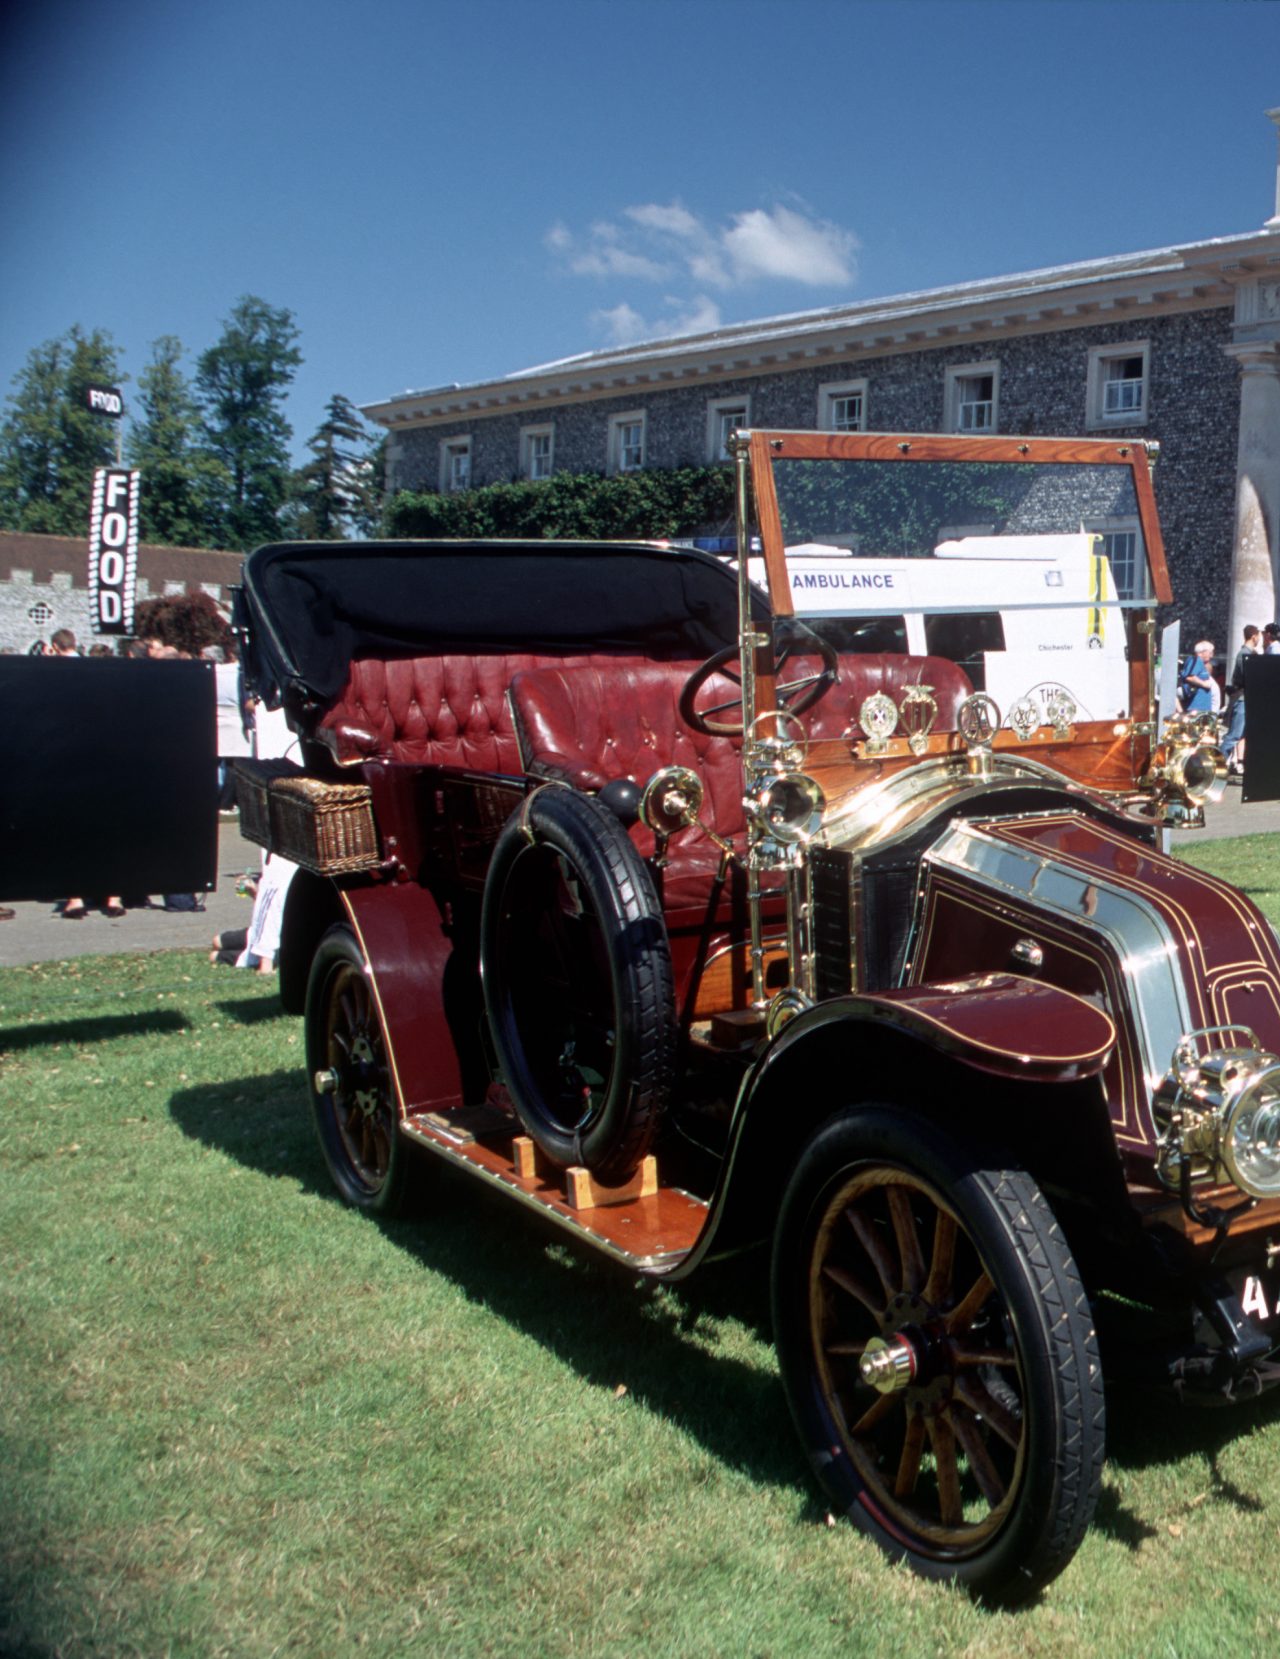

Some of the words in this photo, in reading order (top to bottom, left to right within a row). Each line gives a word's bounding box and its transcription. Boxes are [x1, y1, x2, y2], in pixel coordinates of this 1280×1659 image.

[89, 389, 121, 413] FOOD
[99, 474, 128, 624] FOOD
[793, 574, 894, 588] AMBULANCE
[1038, 643, 1073, 652] Chichester
